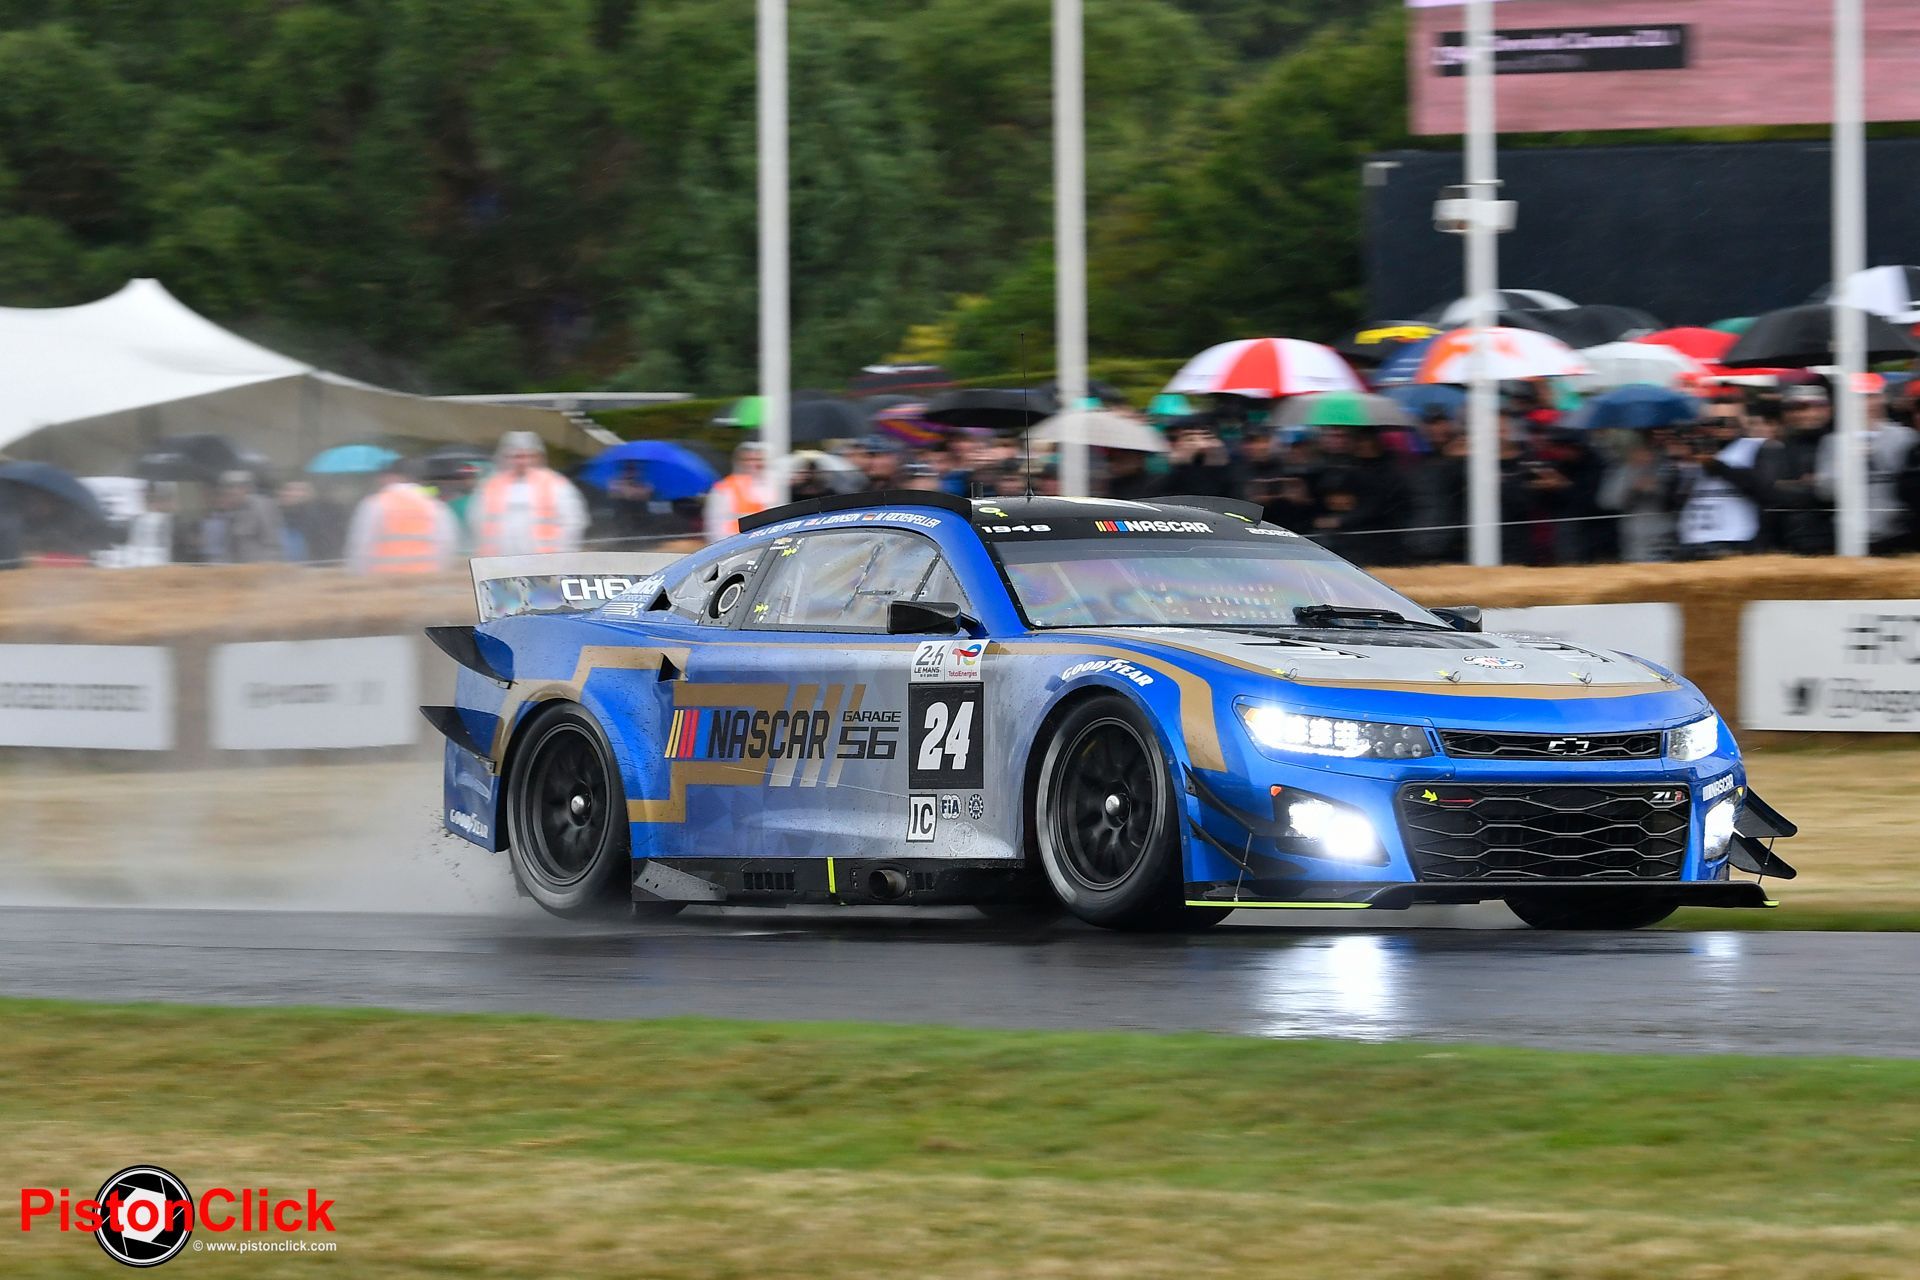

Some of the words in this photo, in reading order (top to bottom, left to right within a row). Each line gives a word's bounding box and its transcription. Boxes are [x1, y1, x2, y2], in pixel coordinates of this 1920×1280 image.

[981, 524, 1052, 534] 1948
[1124, 519, 1214, 534] NASCAR
[913, 666, 923, 674] LE
[922, 666, 940, 674] MANS
[947, 670, 978, 679] TotalEnergies
[1061, 658, 1154, 687] GOODYEAR
[841, 710, 902, 723] GARAGE
[706, 709, 831, 759] NASCAR
[836, 726, 900, 760] 56
[916, 701, 975, 770] 24
[911, 802, 934, 834] IC
